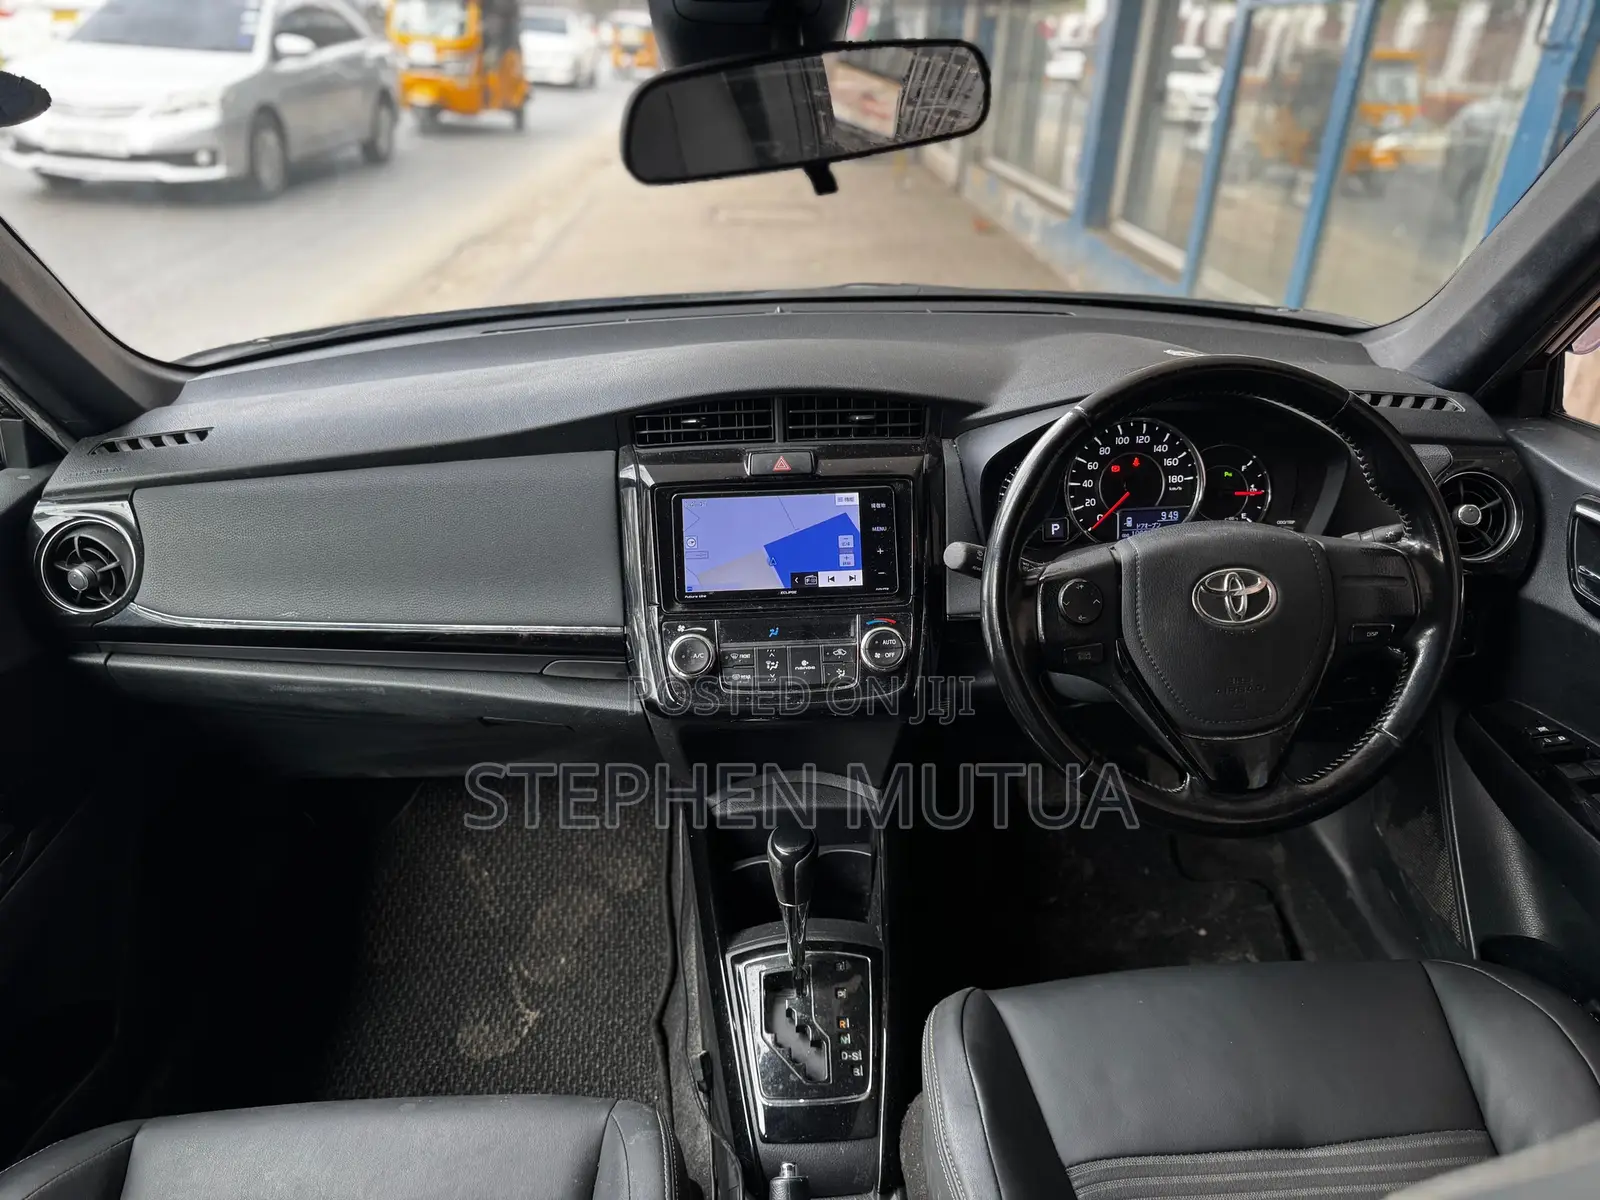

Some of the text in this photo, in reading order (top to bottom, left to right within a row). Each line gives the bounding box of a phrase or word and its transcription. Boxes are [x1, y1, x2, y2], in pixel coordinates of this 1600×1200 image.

[1115, 436, 1130, 445] 100
[1135, 435, 1151, 444] 120
[1099, 446, 1111, 455] 80
[1153, 444, 1169, 453] 140
[1087, 461, 1099, 470] 60
[1163, 458, 1179, 466] 160
[1082, 479, 1094, 488] 40
[1168, 475, 1184, 483] 180
[1085, 498, 1096, 507] 20
[1051, 523, 1060, 535] P
[839, 1020, 846, 1028] R
[840, 1035, 848, 1044] N
[853, 1067, 860, 1076] B
